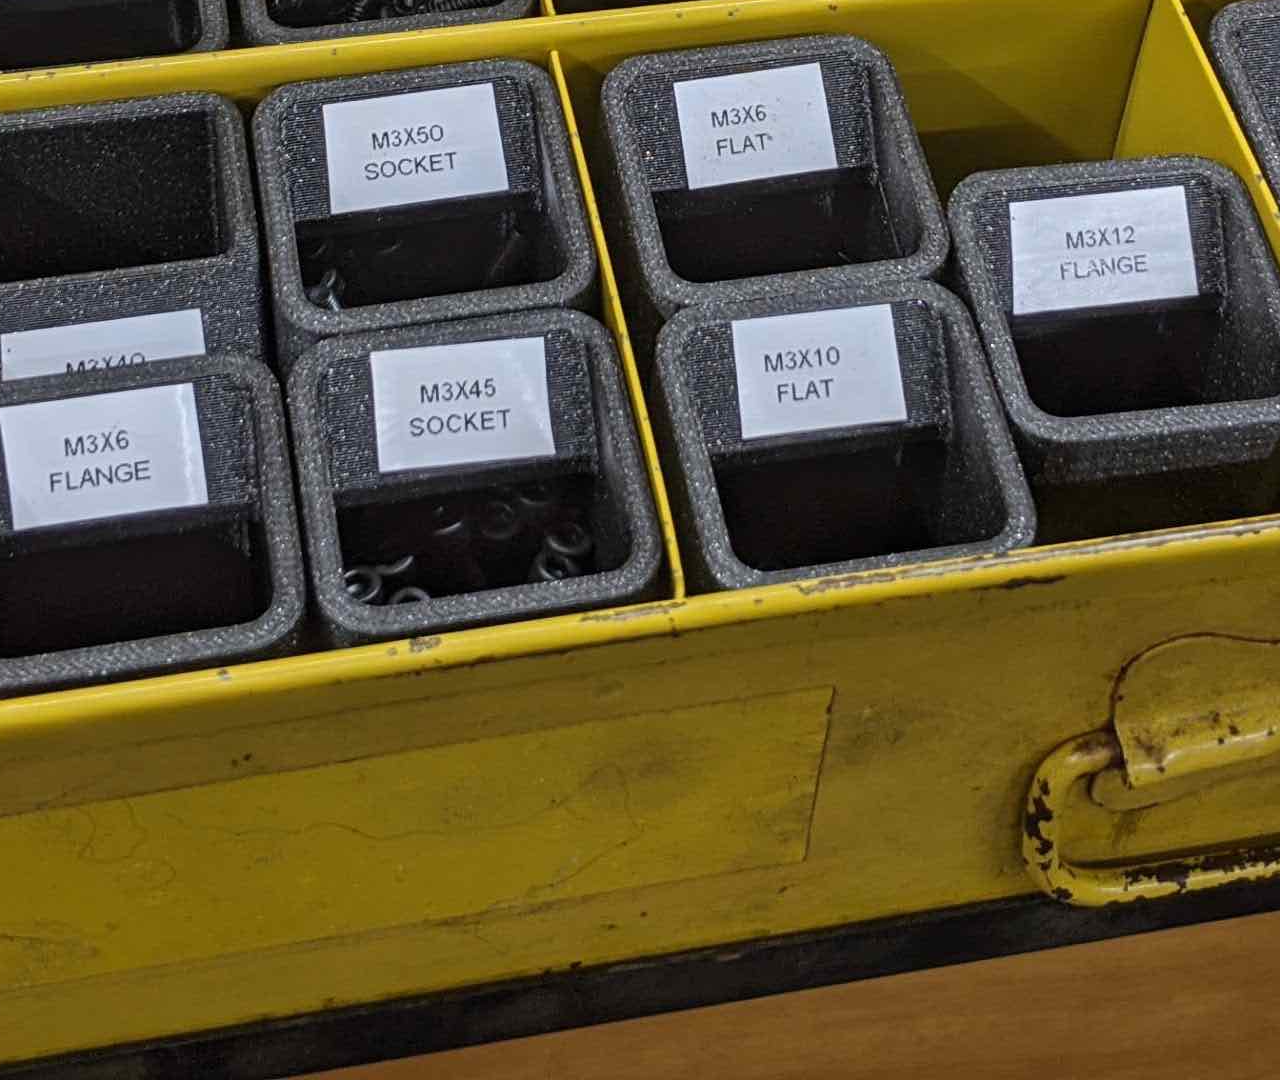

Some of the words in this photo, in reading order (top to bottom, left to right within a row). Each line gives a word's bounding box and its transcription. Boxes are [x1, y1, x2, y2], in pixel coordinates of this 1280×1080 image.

[710, 104, 767, 129] M3X6
[371, 124, 444, 151] M3X50
[715, 132, 768, 157] FLAT
[363, 151, 457, 181] SOCKET
[1065, 225, 1136, 250] M3X12
[1059, 254, 1149, 281] FLANGE
[763, 346, 841, 373] M3X10
[420, 377, 497, 404] M3X45
[776, 378, 834, 404] FLAT
[409, 408, 511, 438] SOCKET
[63, 429, 130, 457] M3X6
[49, 459, 151, 493] FLANGE
